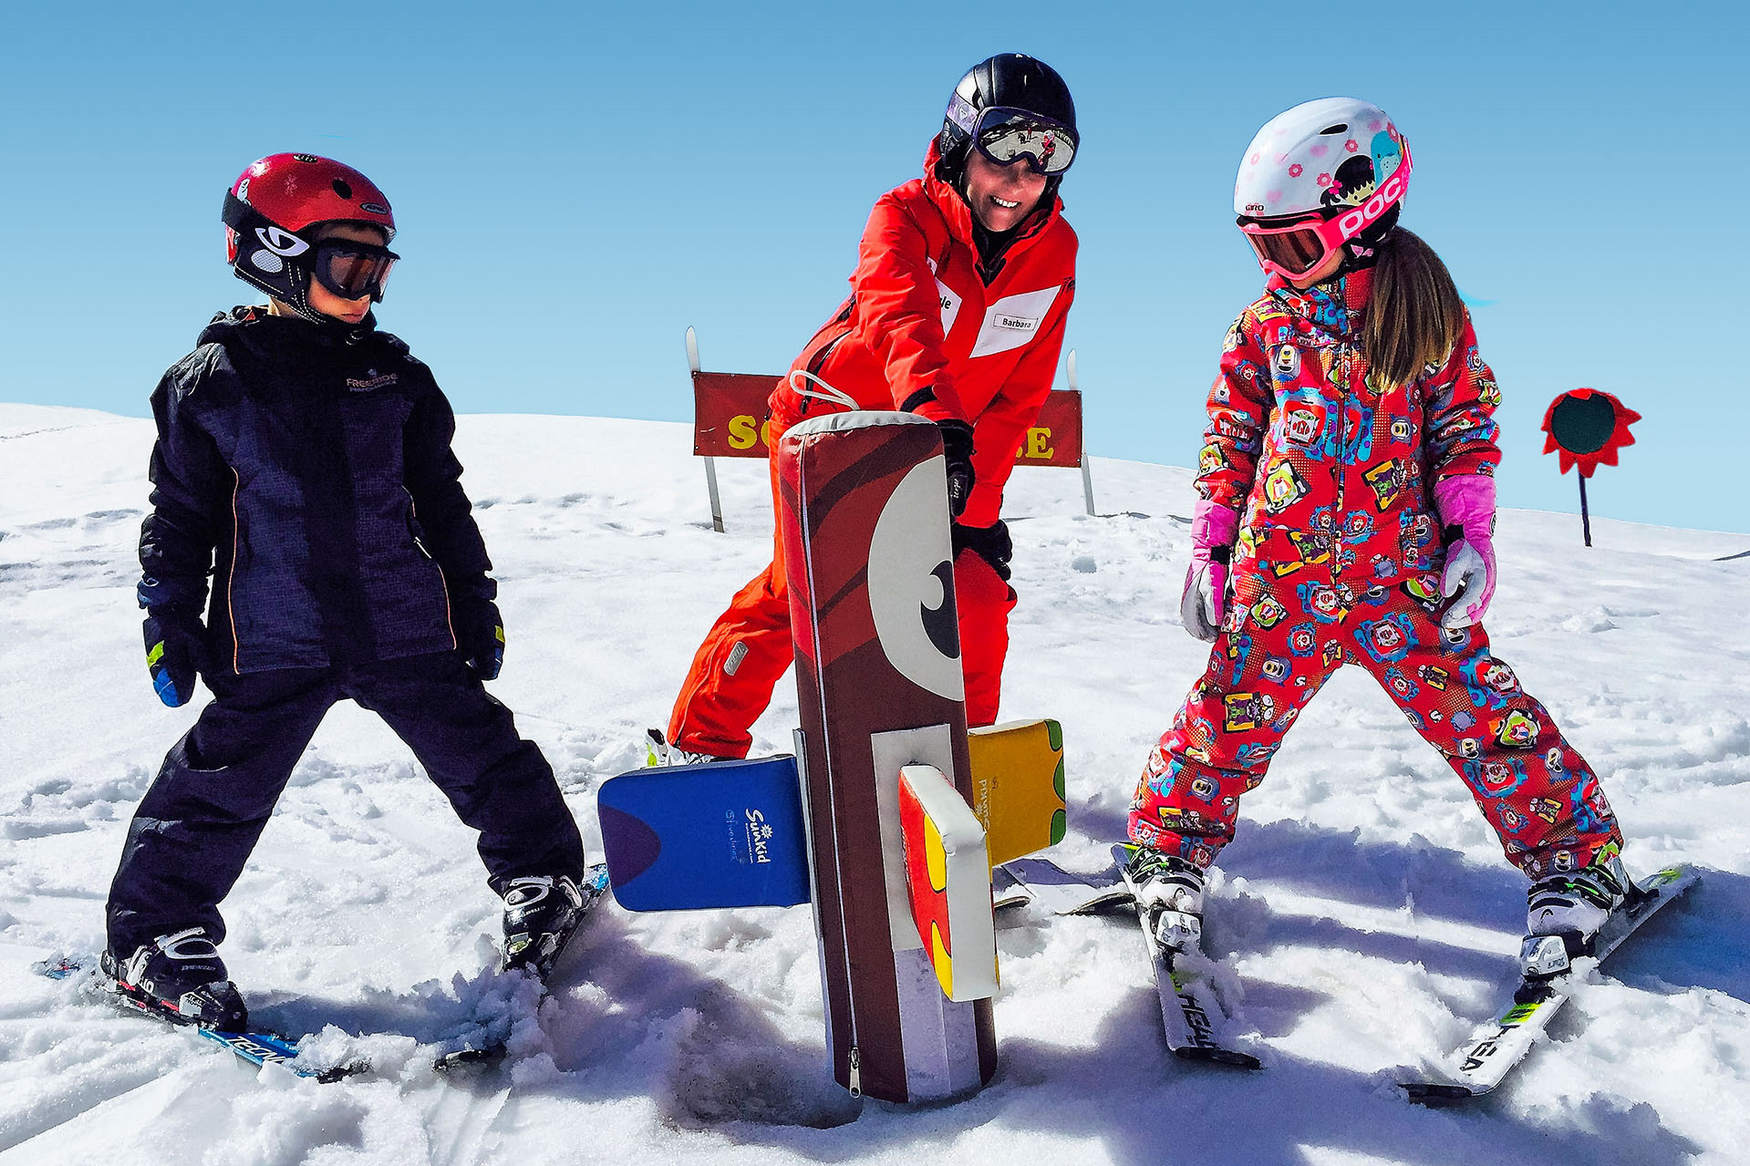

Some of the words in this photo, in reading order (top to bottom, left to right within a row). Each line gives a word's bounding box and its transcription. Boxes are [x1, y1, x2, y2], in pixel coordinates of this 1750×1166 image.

[1002, 318, 1031, 328] Barbara
[728, 415, 769, 449] S
[1015, 427, 1054, 459] E
